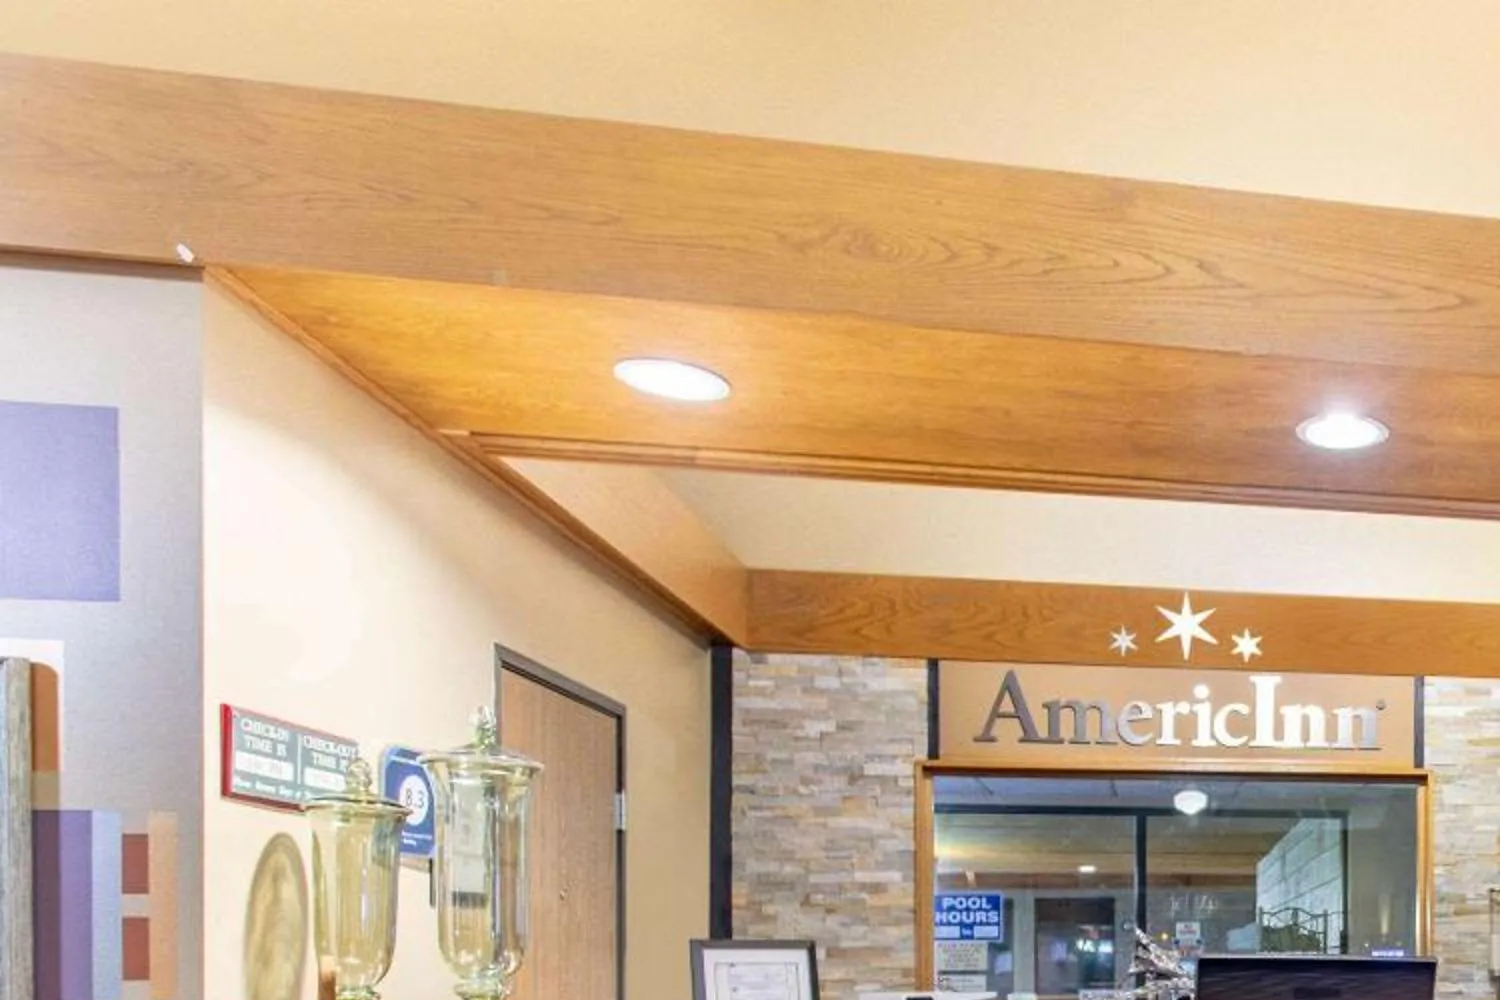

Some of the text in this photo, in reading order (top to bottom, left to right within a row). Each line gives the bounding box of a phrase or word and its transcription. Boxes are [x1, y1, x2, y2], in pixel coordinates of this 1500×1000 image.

[973, 669, 1382, 750] AmericInn
[244, 733, 274, 754] TIME
[312, 750, 338, 769] TIME
[405, 787, 425, 810] 8.3
[942, 897, 993, 910] POOL
[935, 911, 999, 924] HOURS
